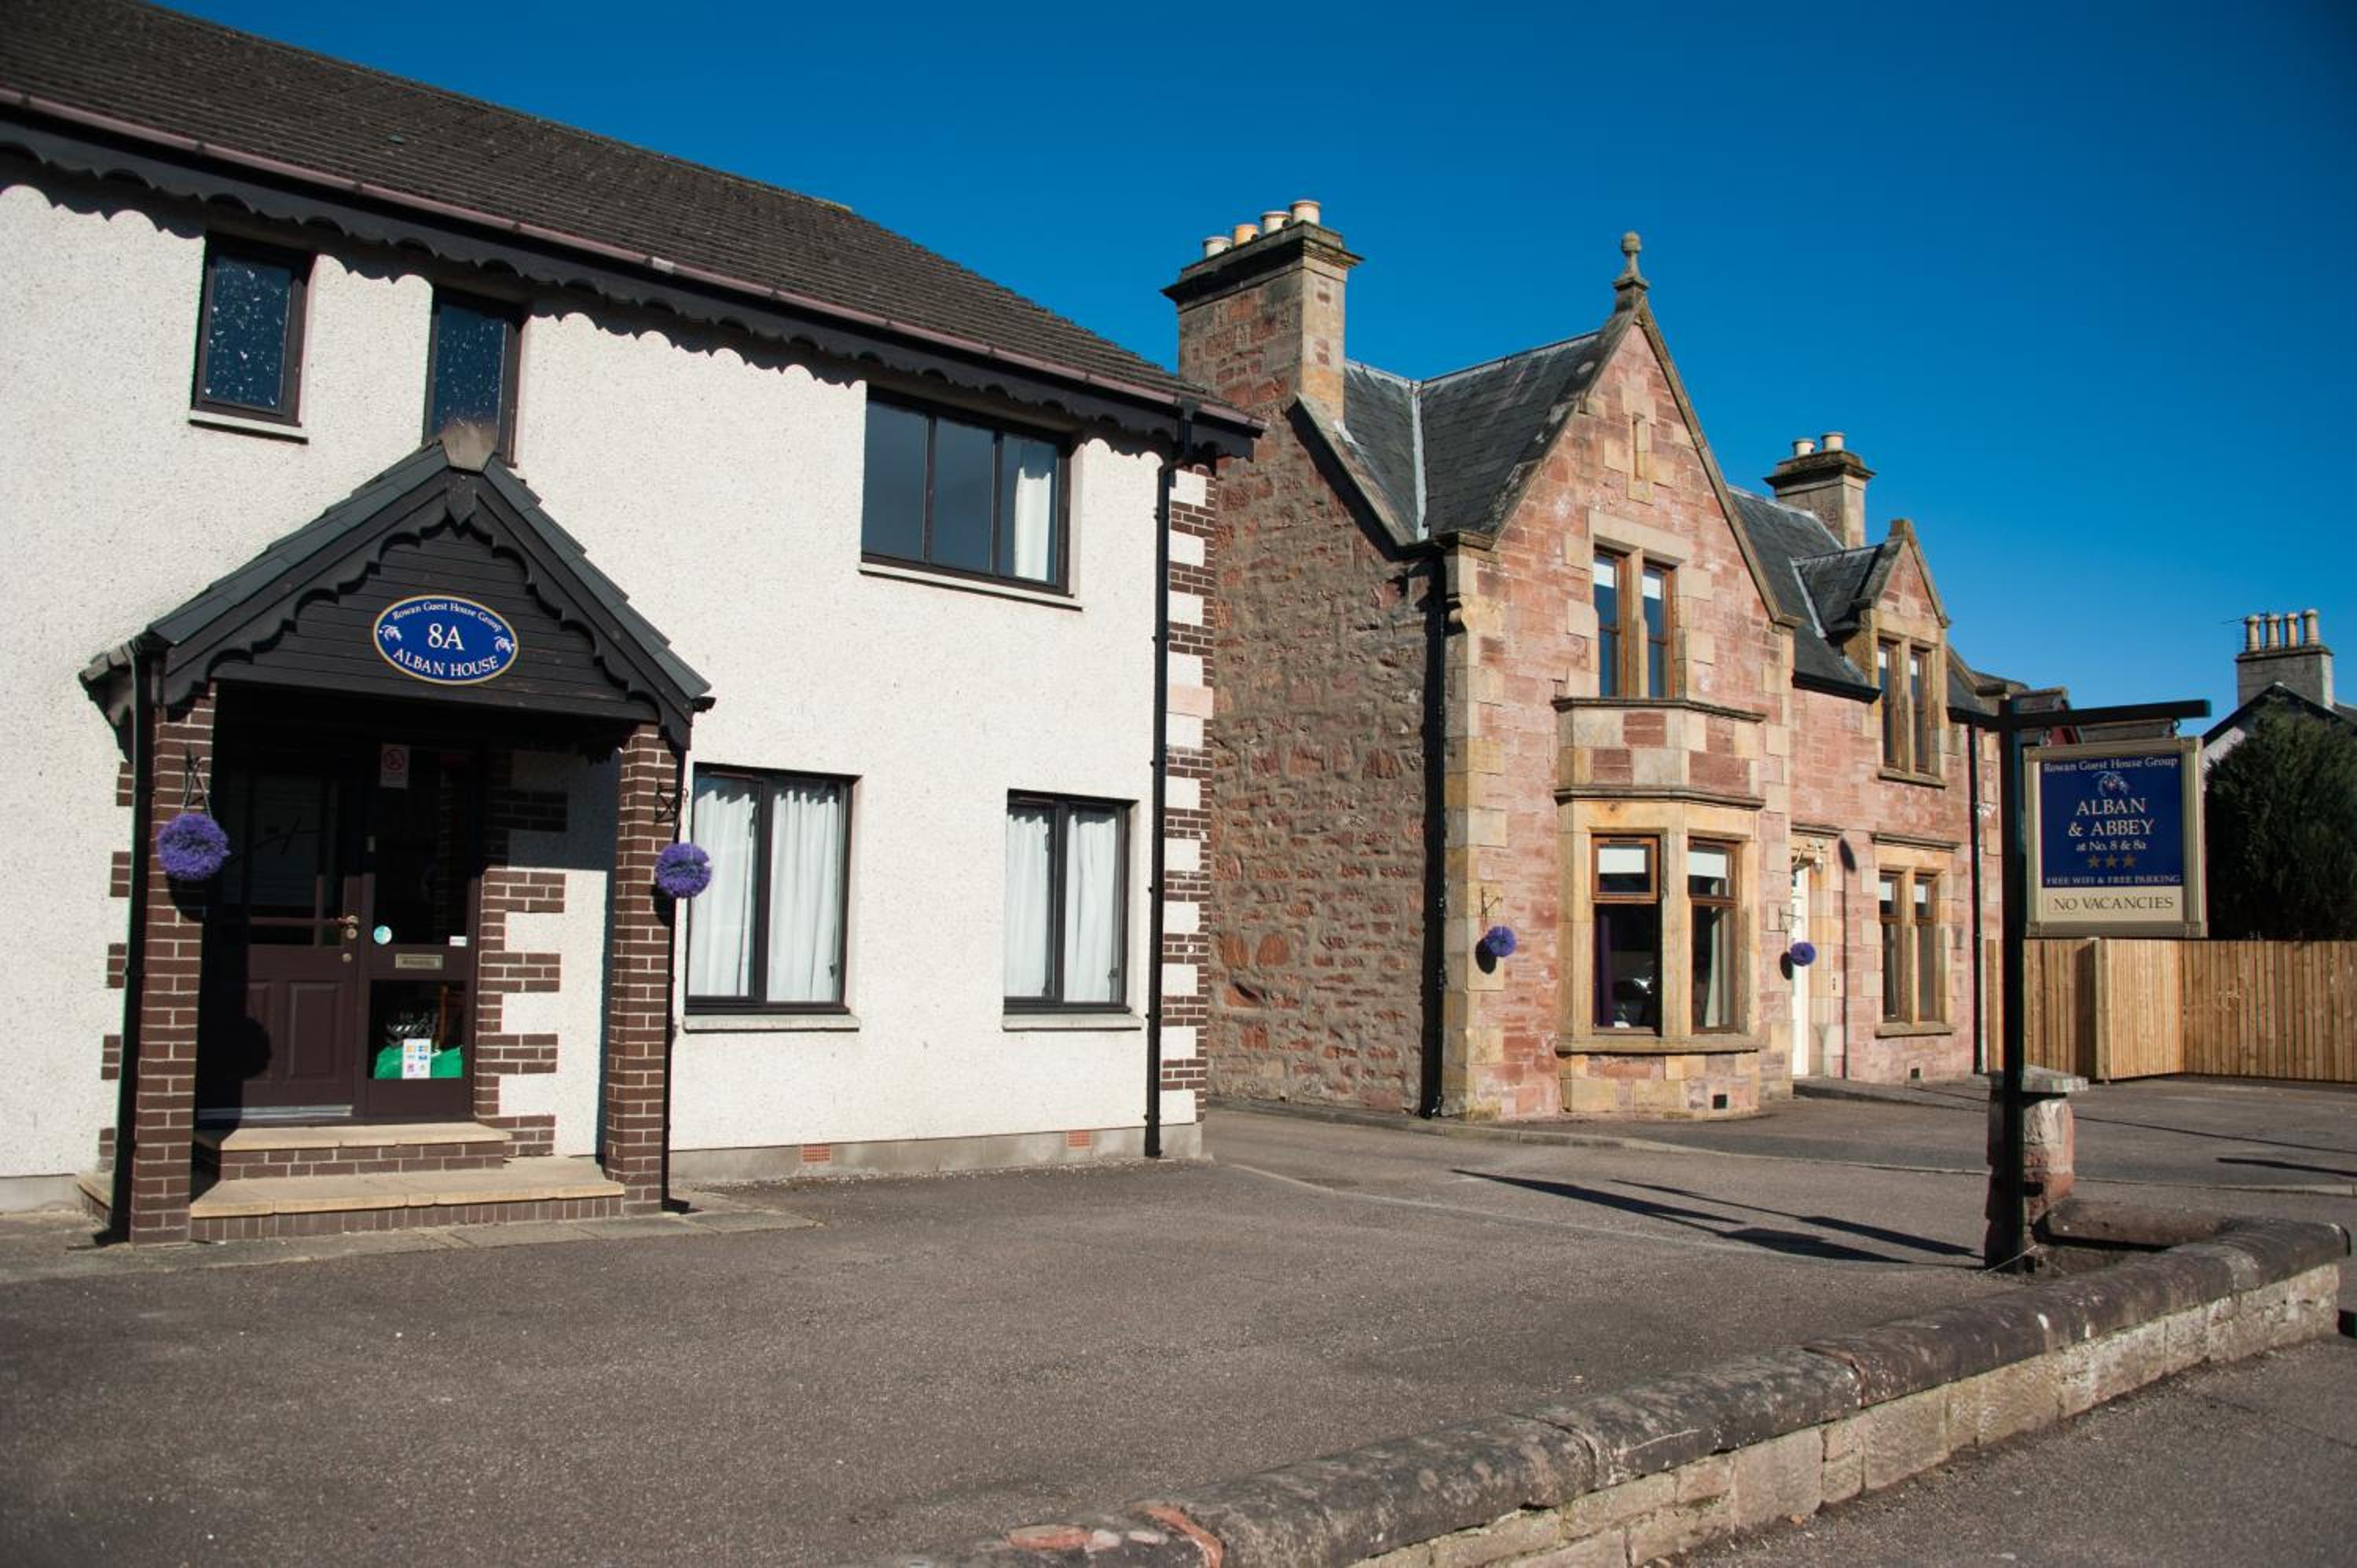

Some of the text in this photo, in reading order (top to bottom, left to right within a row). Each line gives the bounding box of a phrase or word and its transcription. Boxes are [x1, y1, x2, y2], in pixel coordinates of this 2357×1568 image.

[392, 601, 503, 632] Rowan Guest House Group
[427, 623, 465, 651] 8A
[394, 648, 499, 677] ALBAN HOUSE
[2044, 757, 2178, 773] Rowan Guest House Group
[2077, 797, 2147, 815] ALBAN
[2068, 819, 2154, 837] & ABBEY
[2076, 842, 2087, 851] at
[2110, 841, 2118, 850] 8
[2121, 840, 2131, 850] &
[2046, 877, 2069, 885] FREE
[2097, 876, 2105, 885] &
[2108, 875, 2132, 884] FREE
[2135, 874, 2181, 884] PARKING
[2054, 896, 2174, 910] NO VACANCIES
